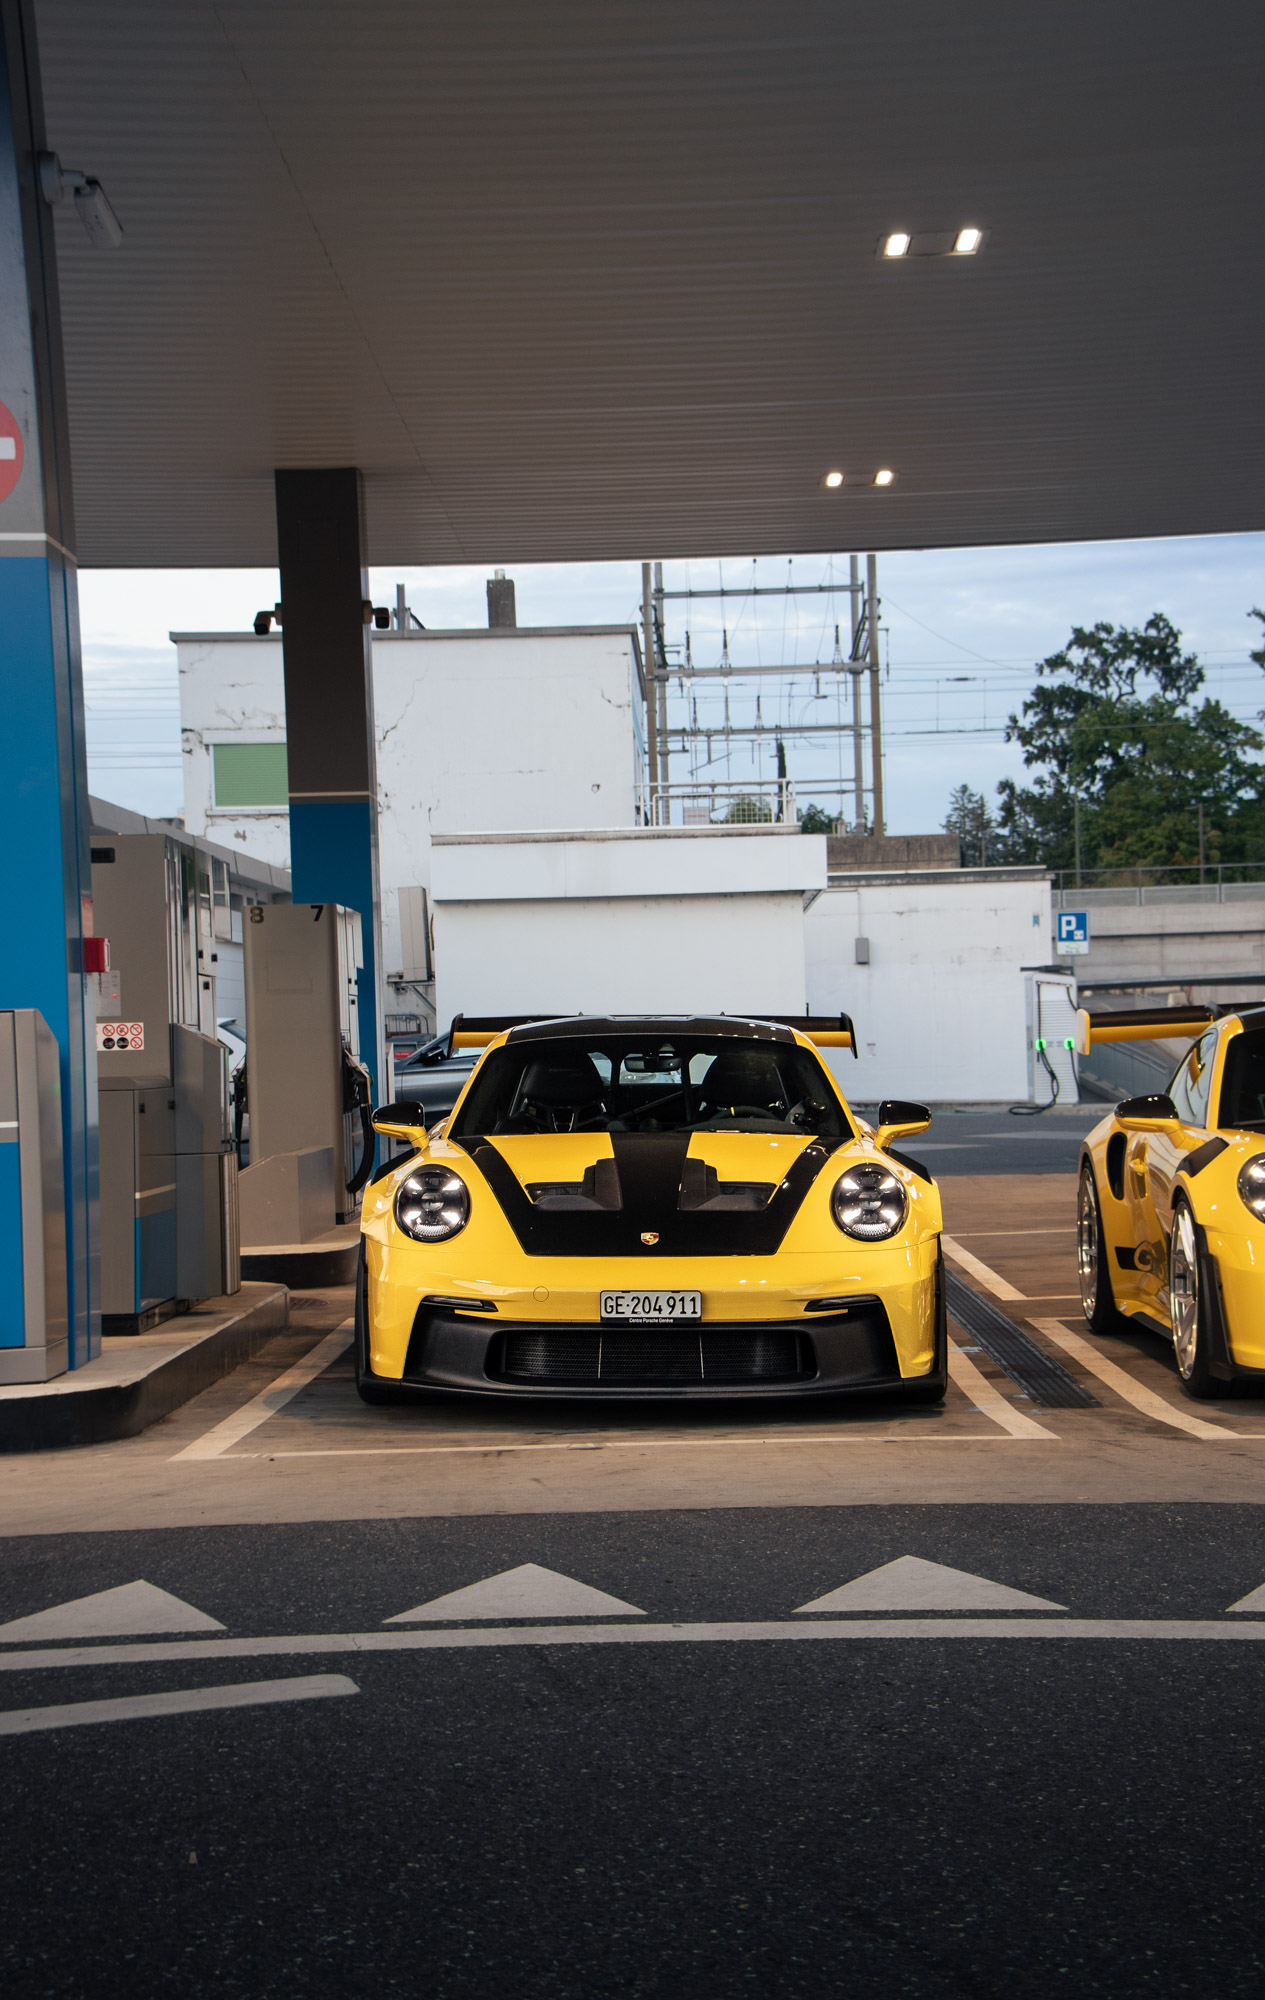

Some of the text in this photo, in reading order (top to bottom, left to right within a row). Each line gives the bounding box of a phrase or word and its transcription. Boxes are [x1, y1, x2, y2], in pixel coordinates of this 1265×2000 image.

[250, 906, 264, 924] 8
[310, 904, 323, 922] 7
[1061, 916, 1076, 938] P
